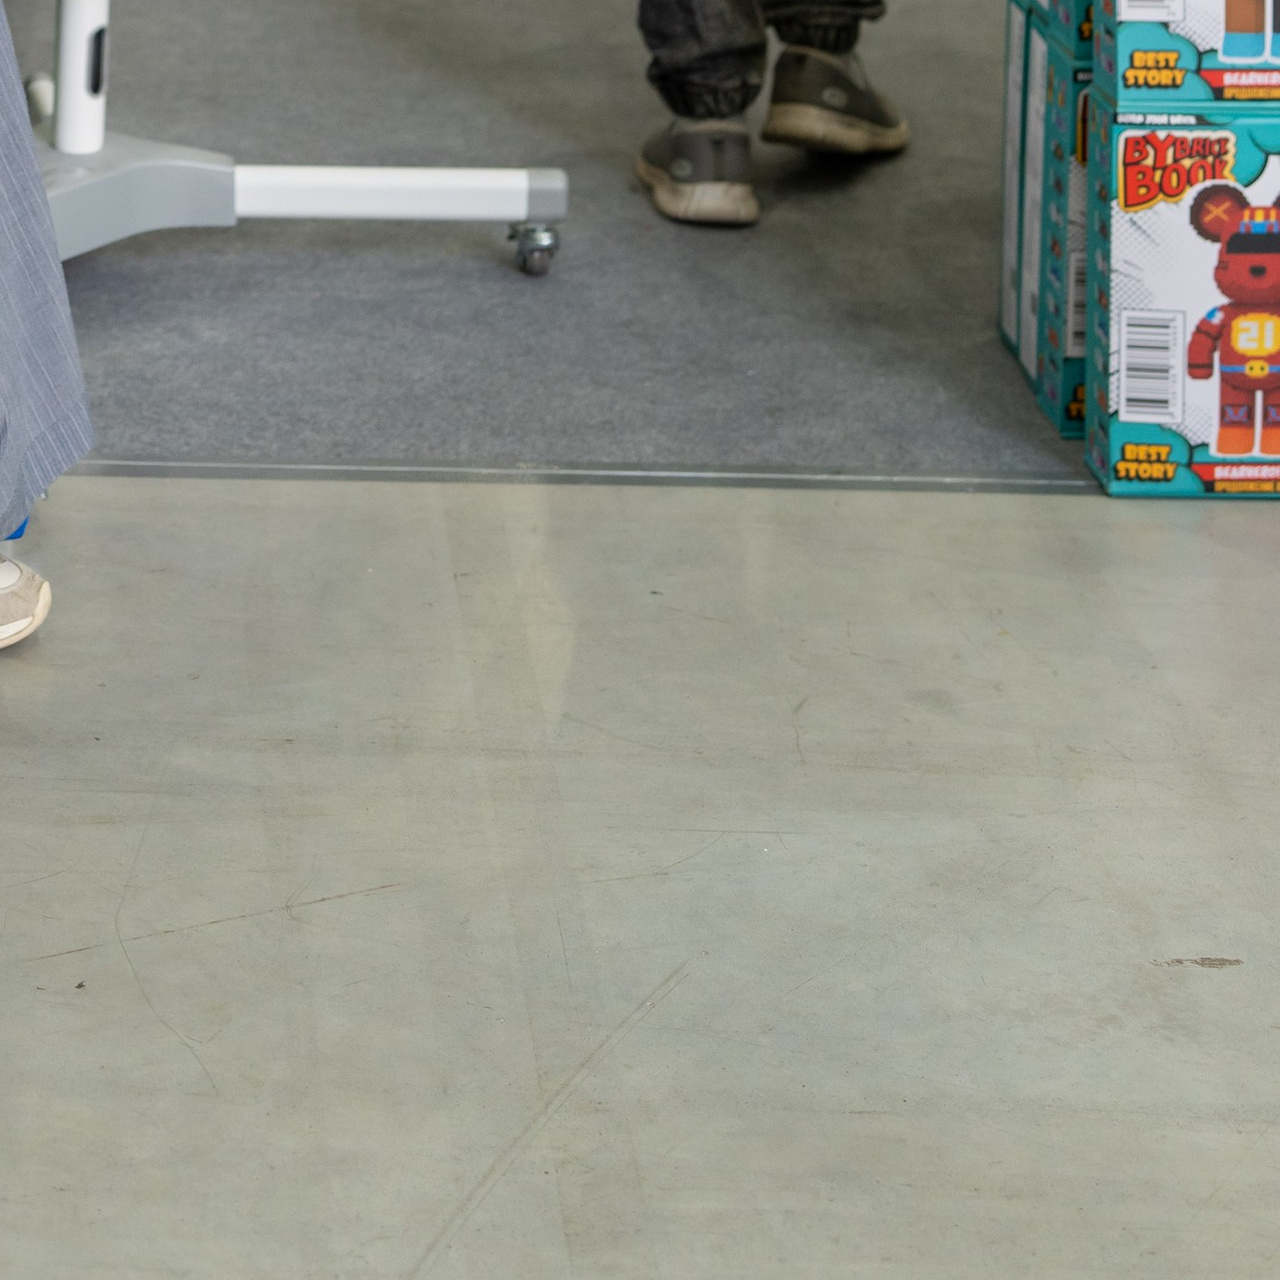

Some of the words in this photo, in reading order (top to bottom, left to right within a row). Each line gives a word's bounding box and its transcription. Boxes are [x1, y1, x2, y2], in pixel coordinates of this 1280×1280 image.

[1132, 51, 1179, 68] BEST
[1124, 68, 1187, 87] STORY
[1125, 157, 1228, 207] BOOK
[1238, 320, 1274, 350] 21
[1124, 443, 1171, 461] BEST
[1116, 460, 1178, 480] STORY
